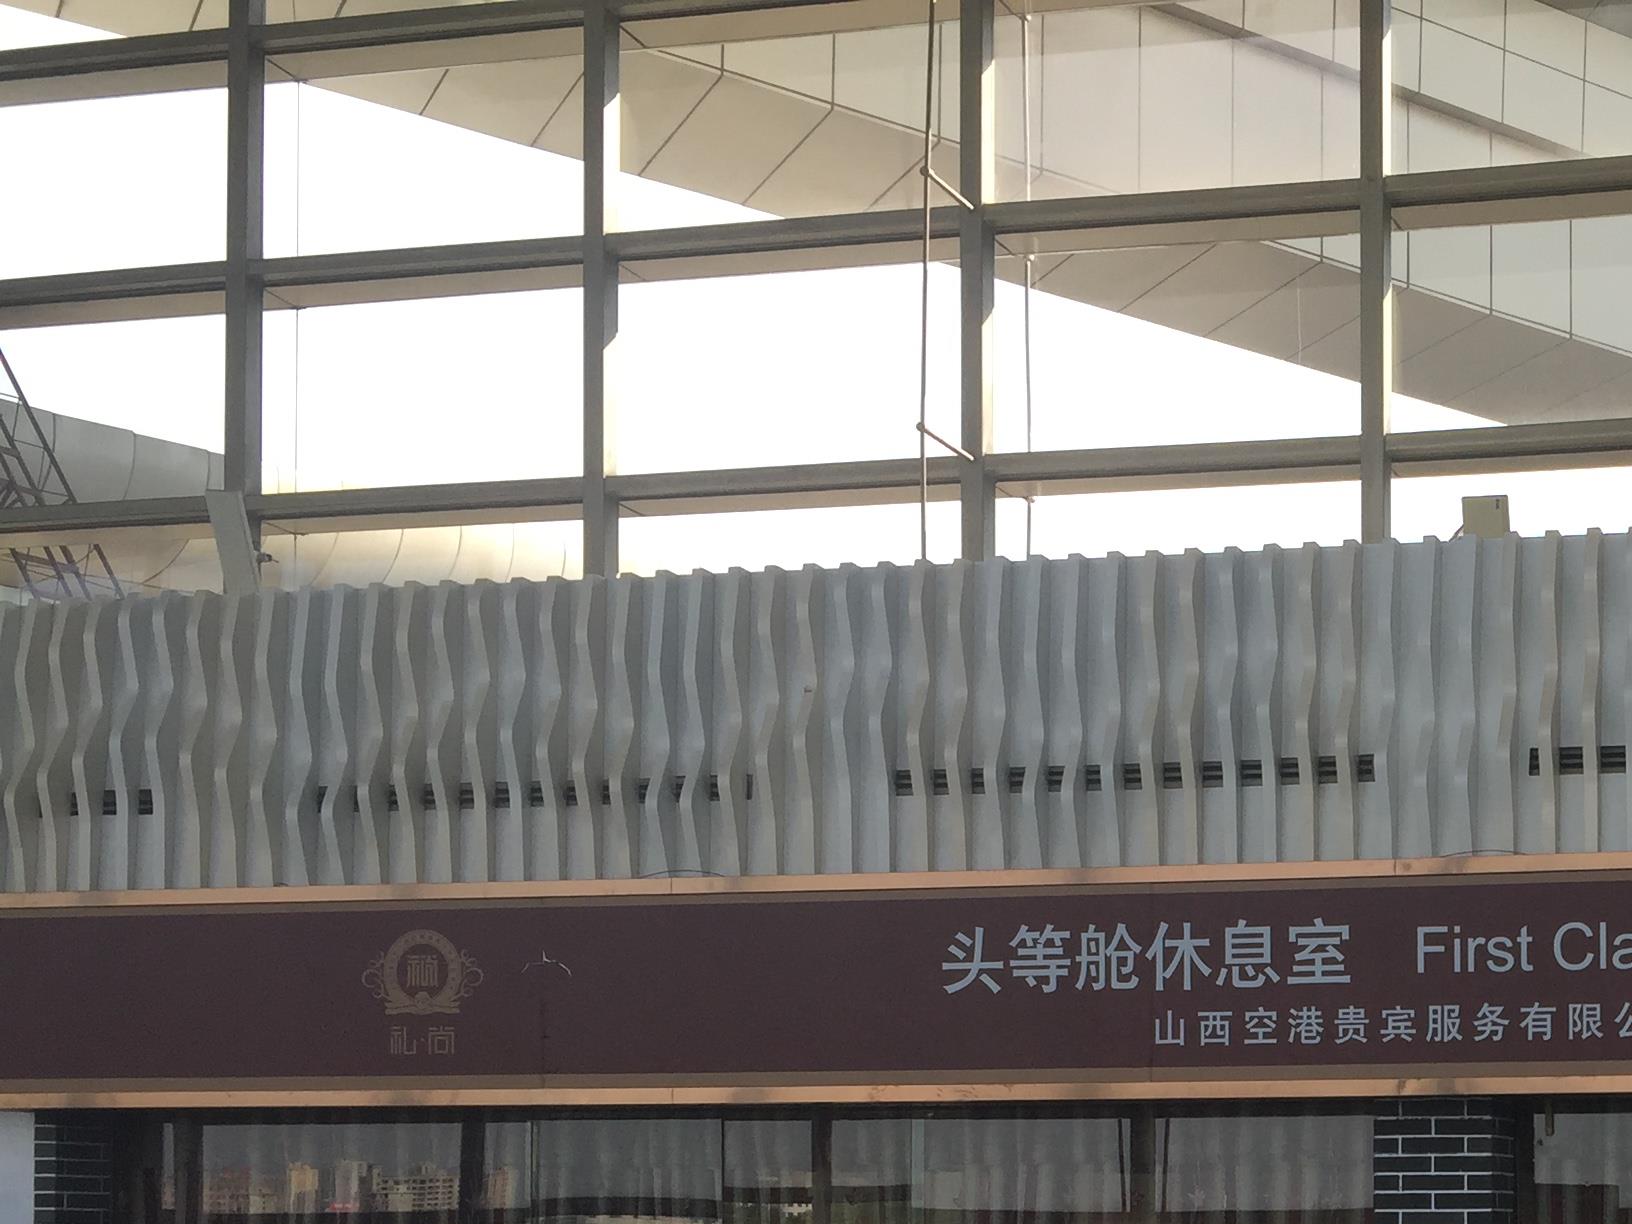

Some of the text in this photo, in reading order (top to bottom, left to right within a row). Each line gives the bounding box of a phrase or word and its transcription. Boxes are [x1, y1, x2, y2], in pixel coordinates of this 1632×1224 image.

[942, 918, 1351, 993] 头等舱休息室
[1416, 925, 1534, 974] First
